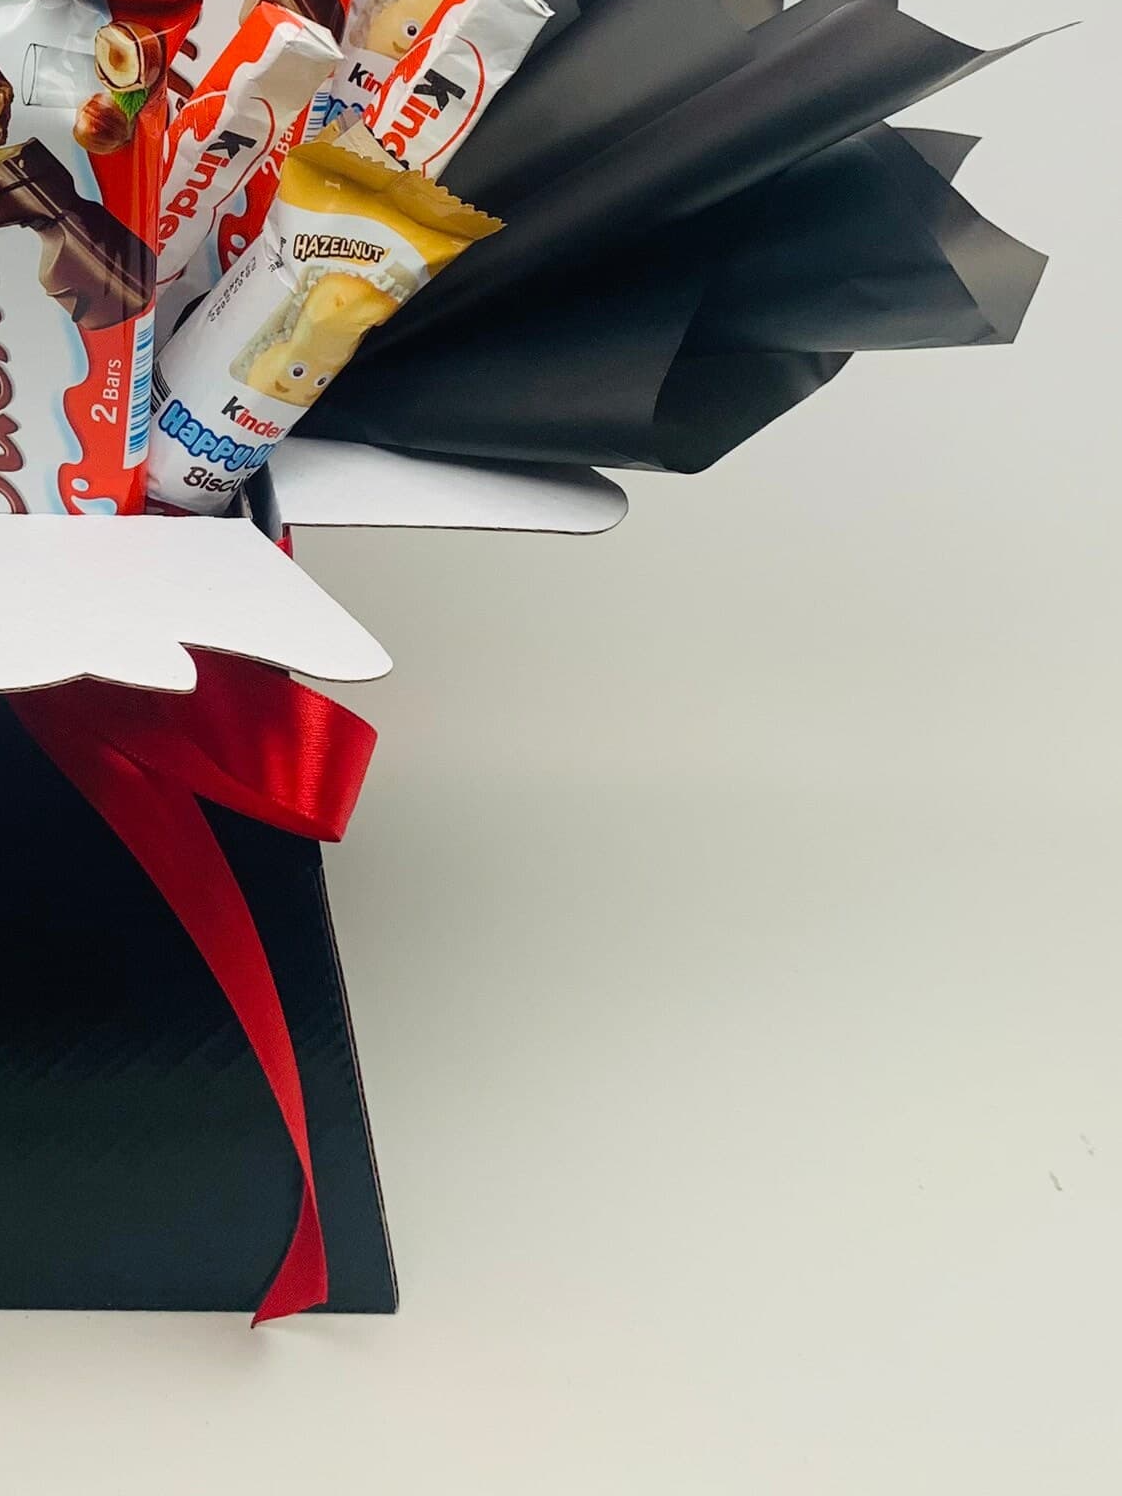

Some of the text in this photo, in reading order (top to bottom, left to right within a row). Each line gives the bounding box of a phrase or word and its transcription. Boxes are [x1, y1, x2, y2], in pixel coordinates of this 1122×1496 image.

[348, 62, 382, 95] Kin
[293, 233, 385, 263] HAZELNUT
[90, 358, 122, 425] 2 Bars
